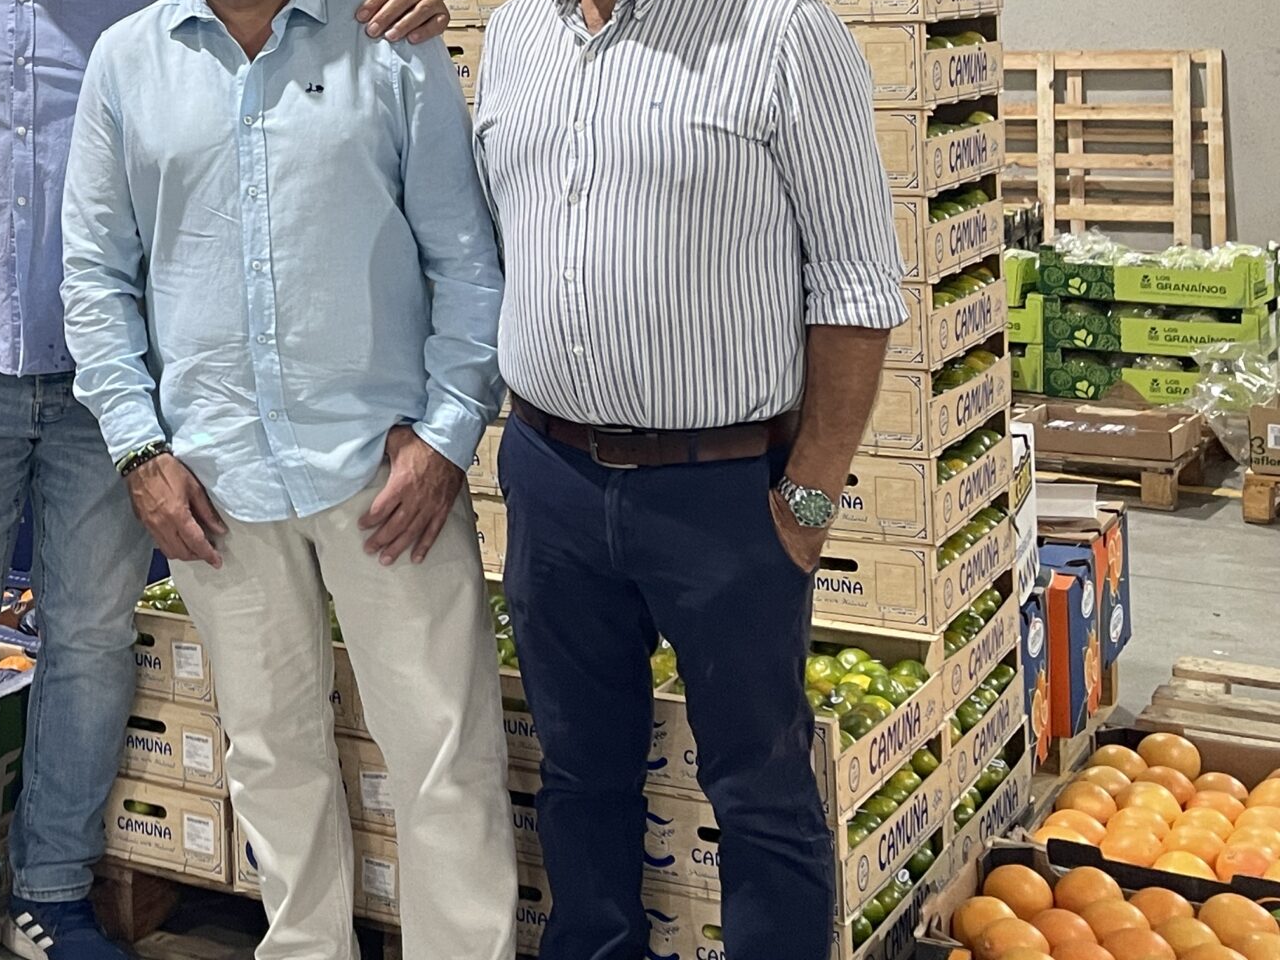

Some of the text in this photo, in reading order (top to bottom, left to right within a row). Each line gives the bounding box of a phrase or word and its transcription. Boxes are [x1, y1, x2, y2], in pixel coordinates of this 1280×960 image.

[948, 47, 988, 87] CAMUÑA
[949, 129, 988, 173] CAMUÑA
[949, 210, 988, 256] CAMUÑA
[1156, 282, 1227, 295] GRANAÍNOS
[955, 292, 992, 341] CAMUÑA
[956, 373, 994, 426] CAMUÑA
[958, 455, 997, 511] CAMUÑA
[817, 576, 863, 595] MUÑA
[960, 536, 999, 596] CAMUÑA
[135, 651, 162, 670] UÑA
[126, 734, 172, 756] AMUÑA
[504, 717, 537, 738] UÑA
[869, 701, 921, 775] CAMUÑA
[972, 697, 1010, 767] CAMUÑA
[117, 816, 172, 840] CAMUÑA
[878, 792, 928, 871] CAMUÑA
[978, 779, 1018, 843] CAMUÑA
[516, 905, 547, 927] UÑA
